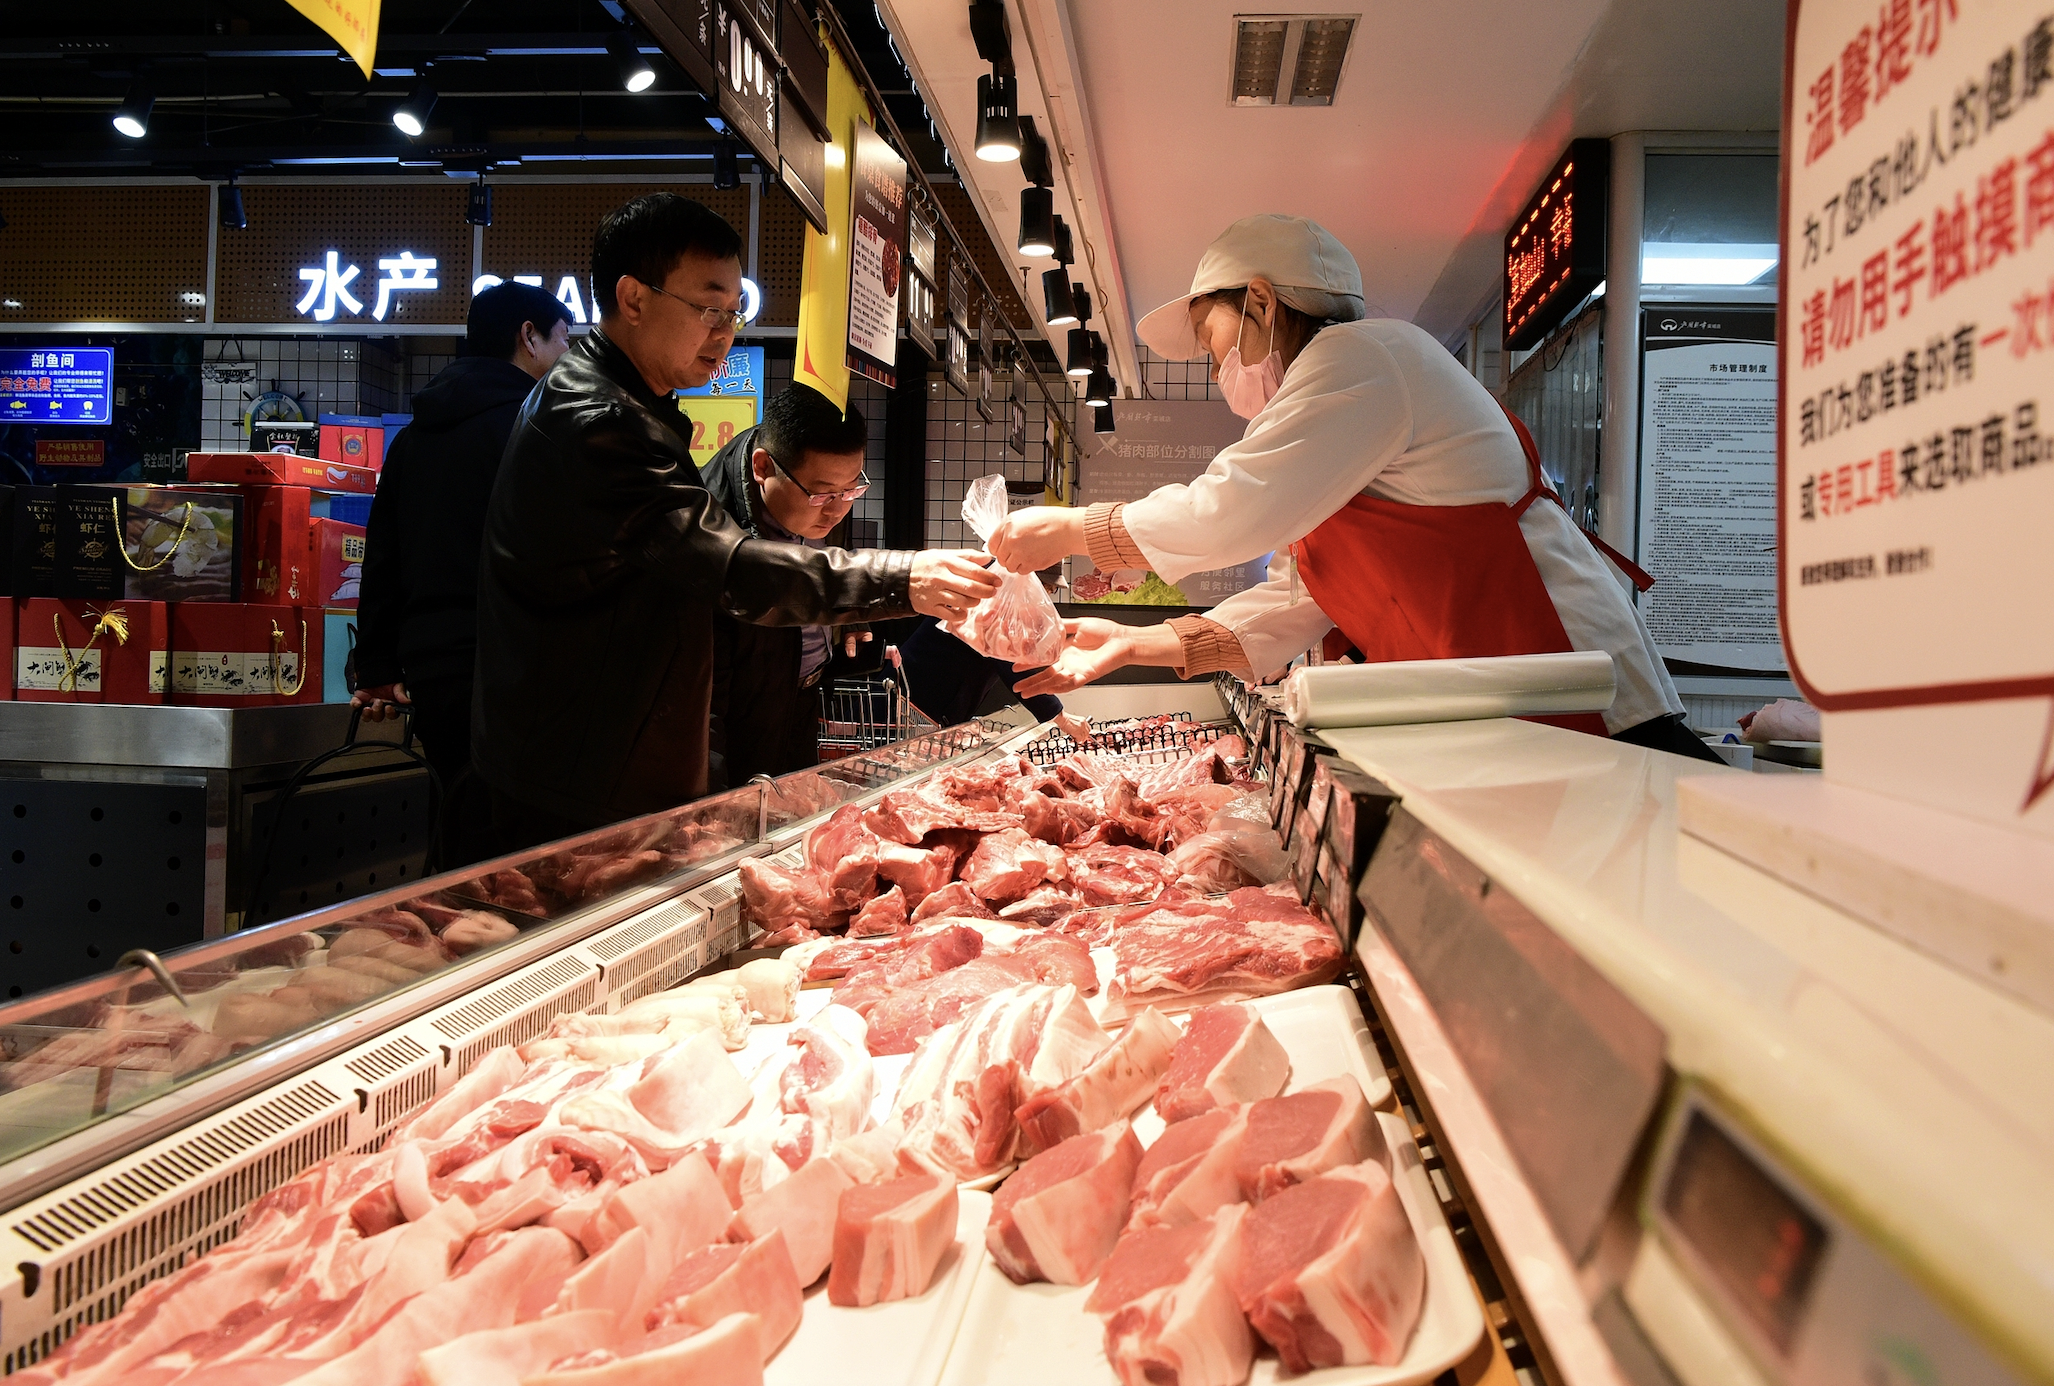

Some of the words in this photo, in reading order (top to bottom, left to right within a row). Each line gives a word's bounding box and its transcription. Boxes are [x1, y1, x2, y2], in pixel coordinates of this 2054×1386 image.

[295, 250, 438, 322] 水产
[31, 353, 75, 368] 剖鱼间
[1801, 283, 2054, 447] 我们为您准备的有一次
[1709, 364, 1768, 373] 市场管理制度
[0, 377, 52, 392] 完全免费
[710, 379, 755, 395] 每一天
[38, 453, 102, 463] 野生动物及其制品
[1118, 445, 1216, 460] 猪肉部位分割图
[143, 453, 171, 468] 安全出口
[80, 522, 106, 534] 虾仁
[1200, 581, 1245, 591] 服务社区
